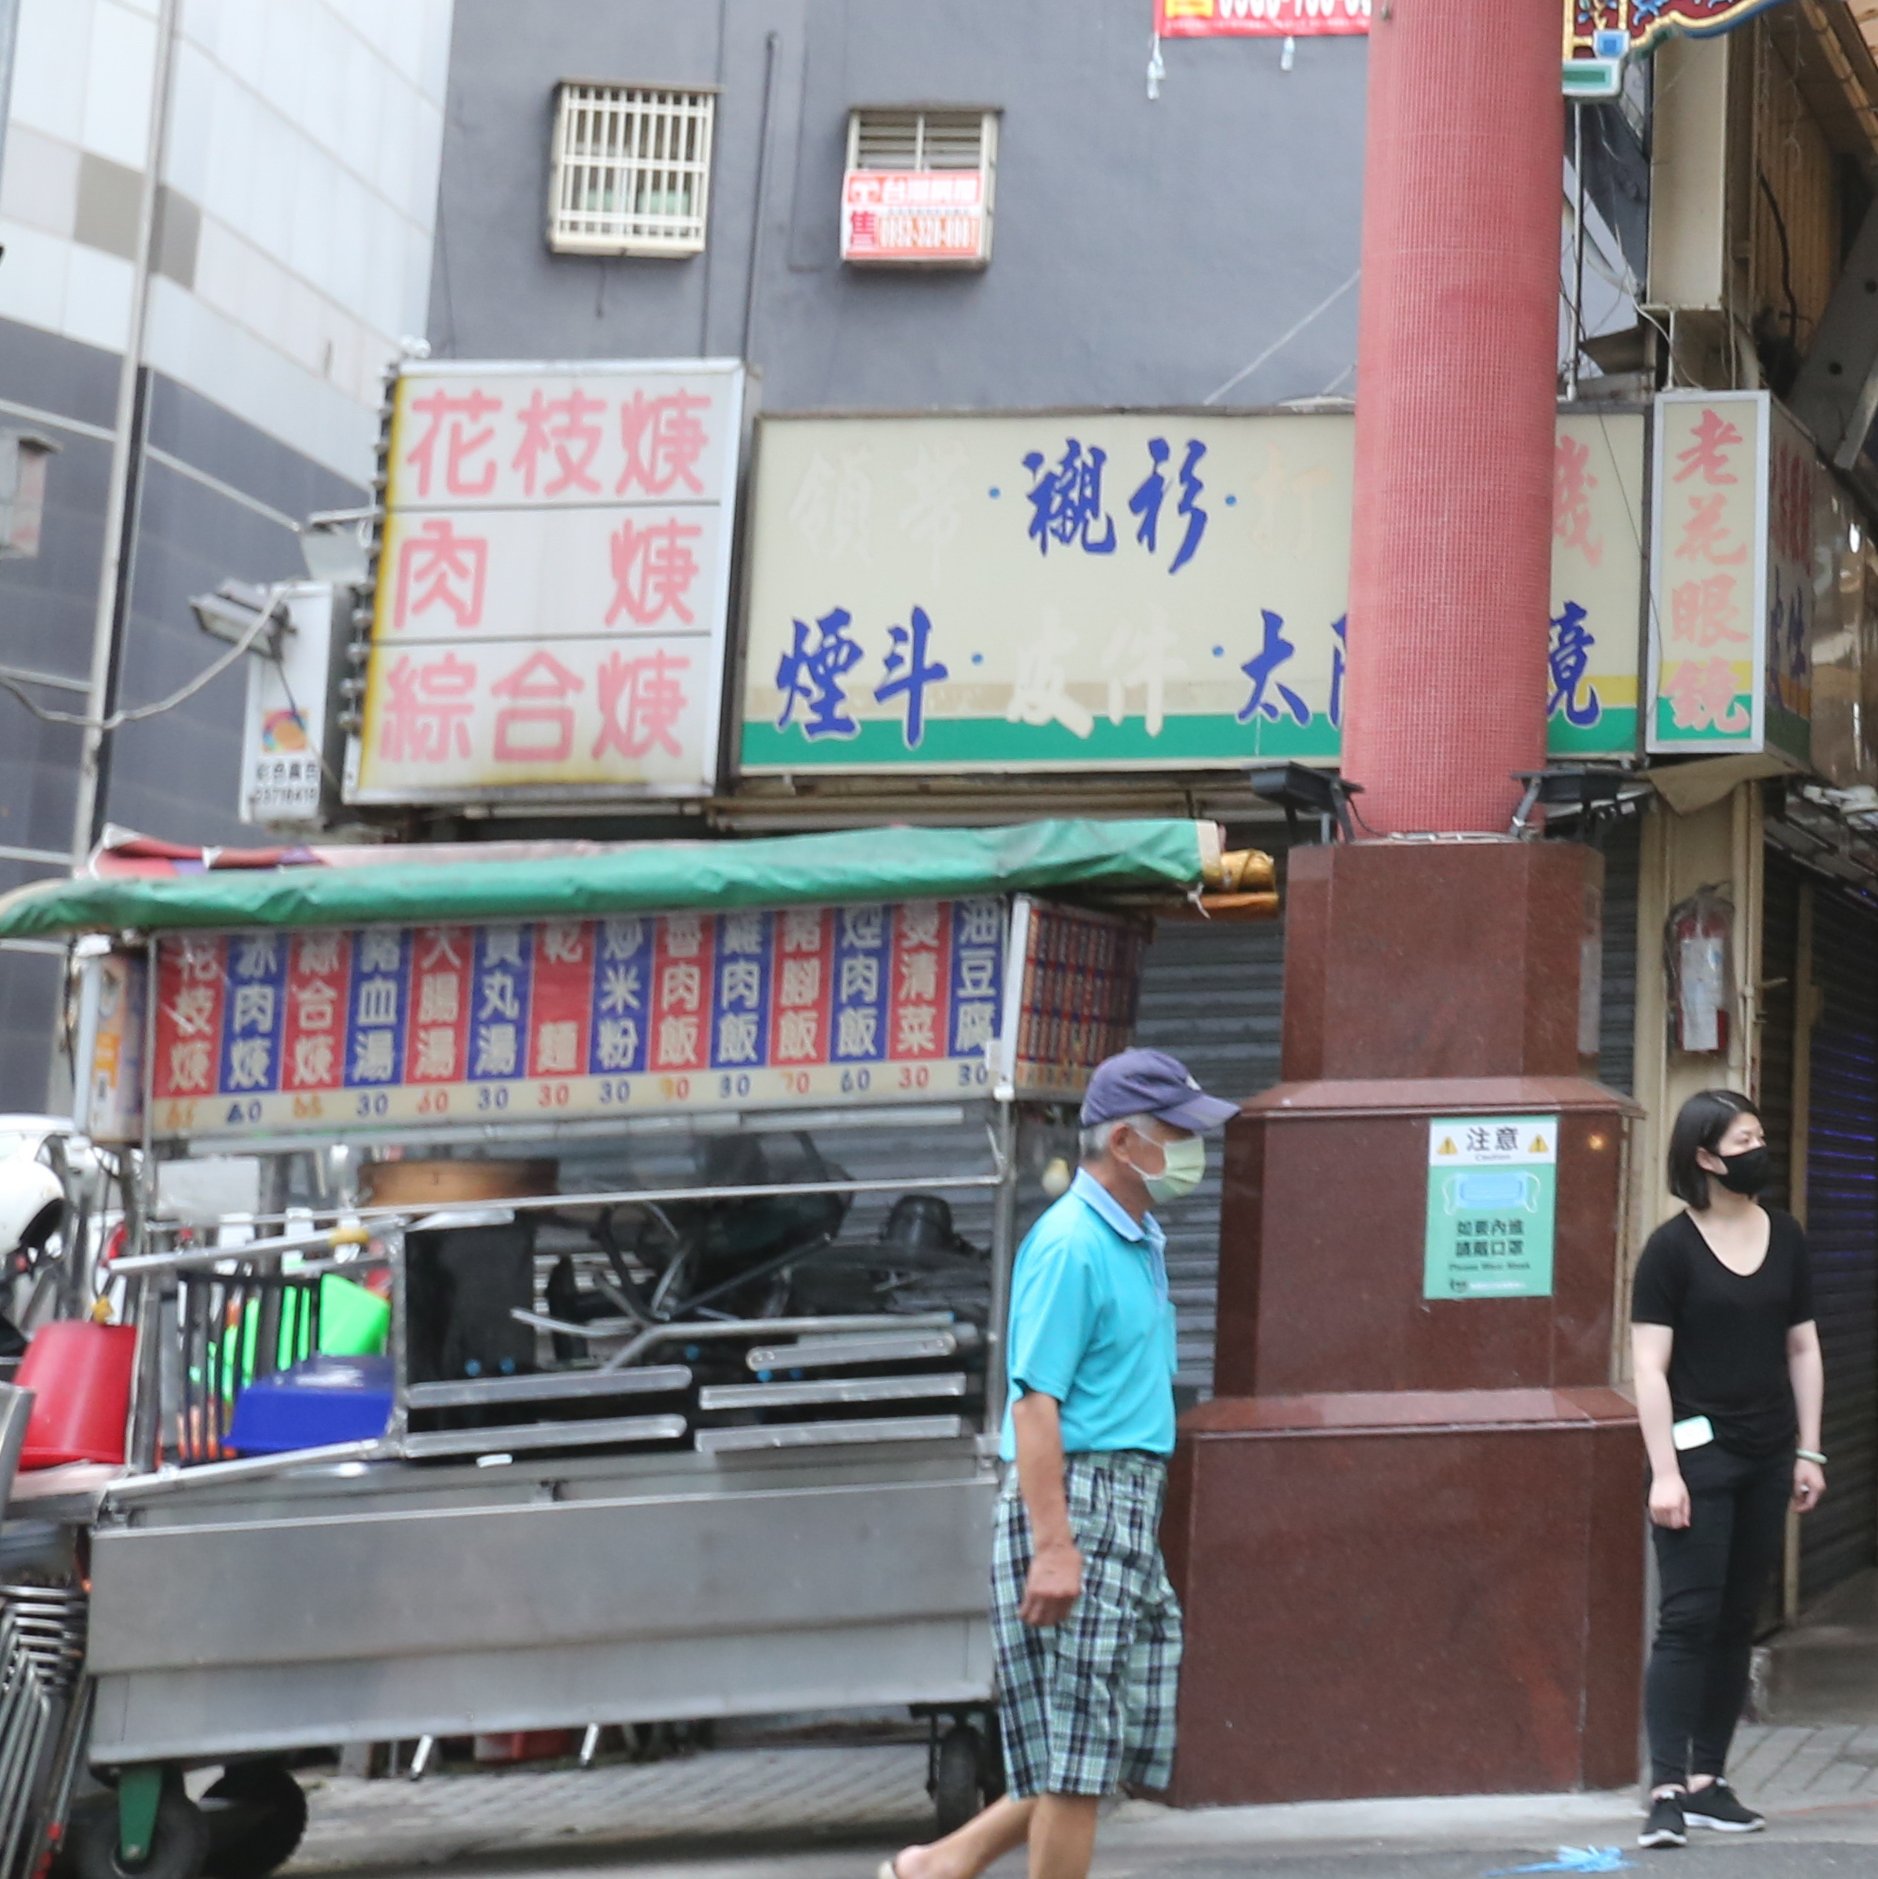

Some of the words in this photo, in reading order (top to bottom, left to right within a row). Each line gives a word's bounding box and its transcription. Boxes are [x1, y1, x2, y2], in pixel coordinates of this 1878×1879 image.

[407, 388, 712, 497] 花枝焿
[1664, 408, 1751, 734] 老花眼鏡
[379, 649, 690, 763] 綜合焿
[775, 603, 949, 749] 煙斗
[357, 1093, 389, 1118] 30
[478, 1087, 509, 1111] 30
[539, 1084, 570, 1108] 30
[600, 1080, 630, 1104] 30
[900, 1066, 929, 1089] 30
[959, 1063, 988, 1087] 30
[1466, 1126, 1520, 1151] 注意
